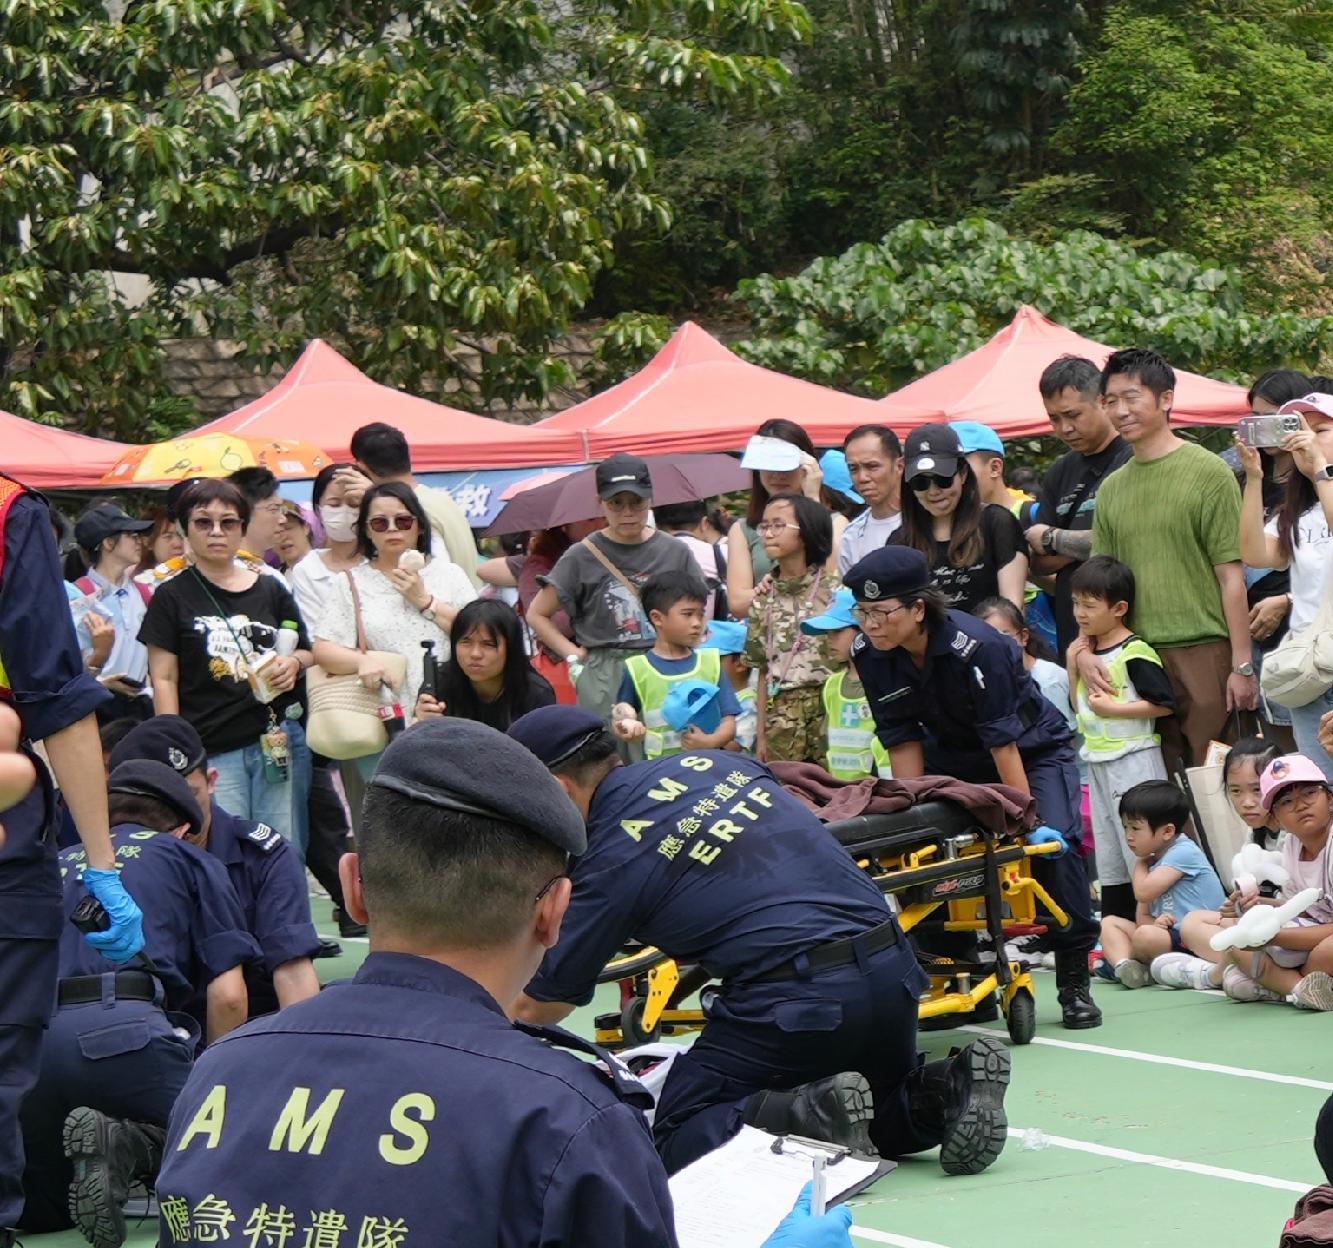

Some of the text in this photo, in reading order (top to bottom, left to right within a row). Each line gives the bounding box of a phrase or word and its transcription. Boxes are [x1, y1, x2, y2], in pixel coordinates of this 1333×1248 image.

[620, 756, 714, 842] AMS
[657, 770, 752, 861] 應急特遣隊
[688, 787, 773, 866] ERTF
[177, 1085, 436, 1165] AMS
